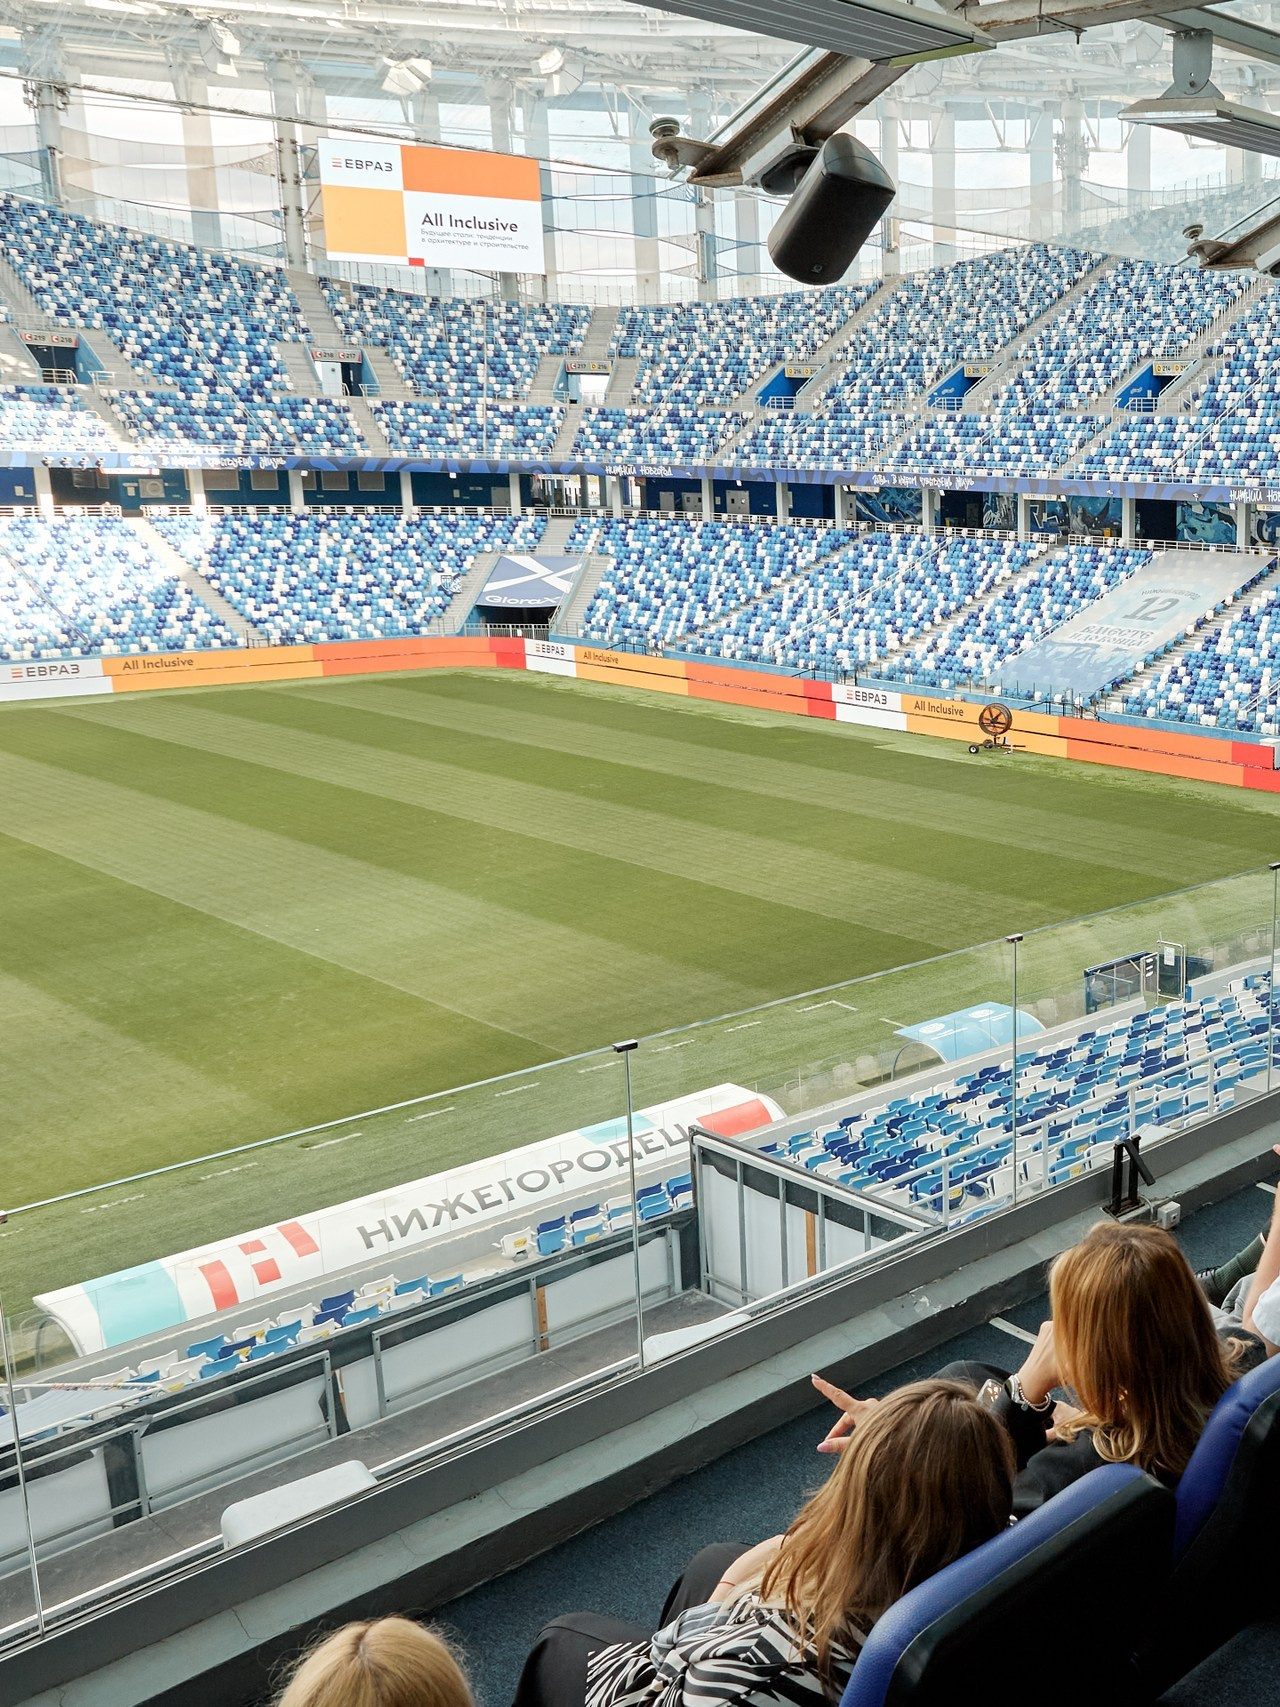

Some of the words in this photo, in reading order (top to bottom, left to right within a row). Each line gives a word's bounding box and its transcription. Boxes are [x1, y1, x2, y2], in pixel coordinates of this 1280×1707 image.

[345, 158, 393, 172] ЕВРАЗ
[421, 213, 443, 227] All
[449, 214, 518, 232] Inclusive
[427, 237, 471, 246] архитектуре
[480, 241, 529, 250] строительстве
[1229, 488, 1262, 503] НИЖНИЙ
[485, 595, 561, 605] GloraX
[1121, 596, 1180, 621] 12
[541, 644, 565, 656] ЕВРАЗ
[122, 660, 139, 670] All
[143, 657, 194, 669] Inclusive
[583, 651, 592, 659] All
[593, 652, 619, 664] Inclusive
[26, 664, 81, 677] ЕВРАЗ
[855, 690, 888, 705] ЕВРАЗ
[914, 700, 926, 711] All
[928, 702, 964, 716] Inclusive
[356, 1123, 691, 1249] НИЖЕГОРОДЕЦ
